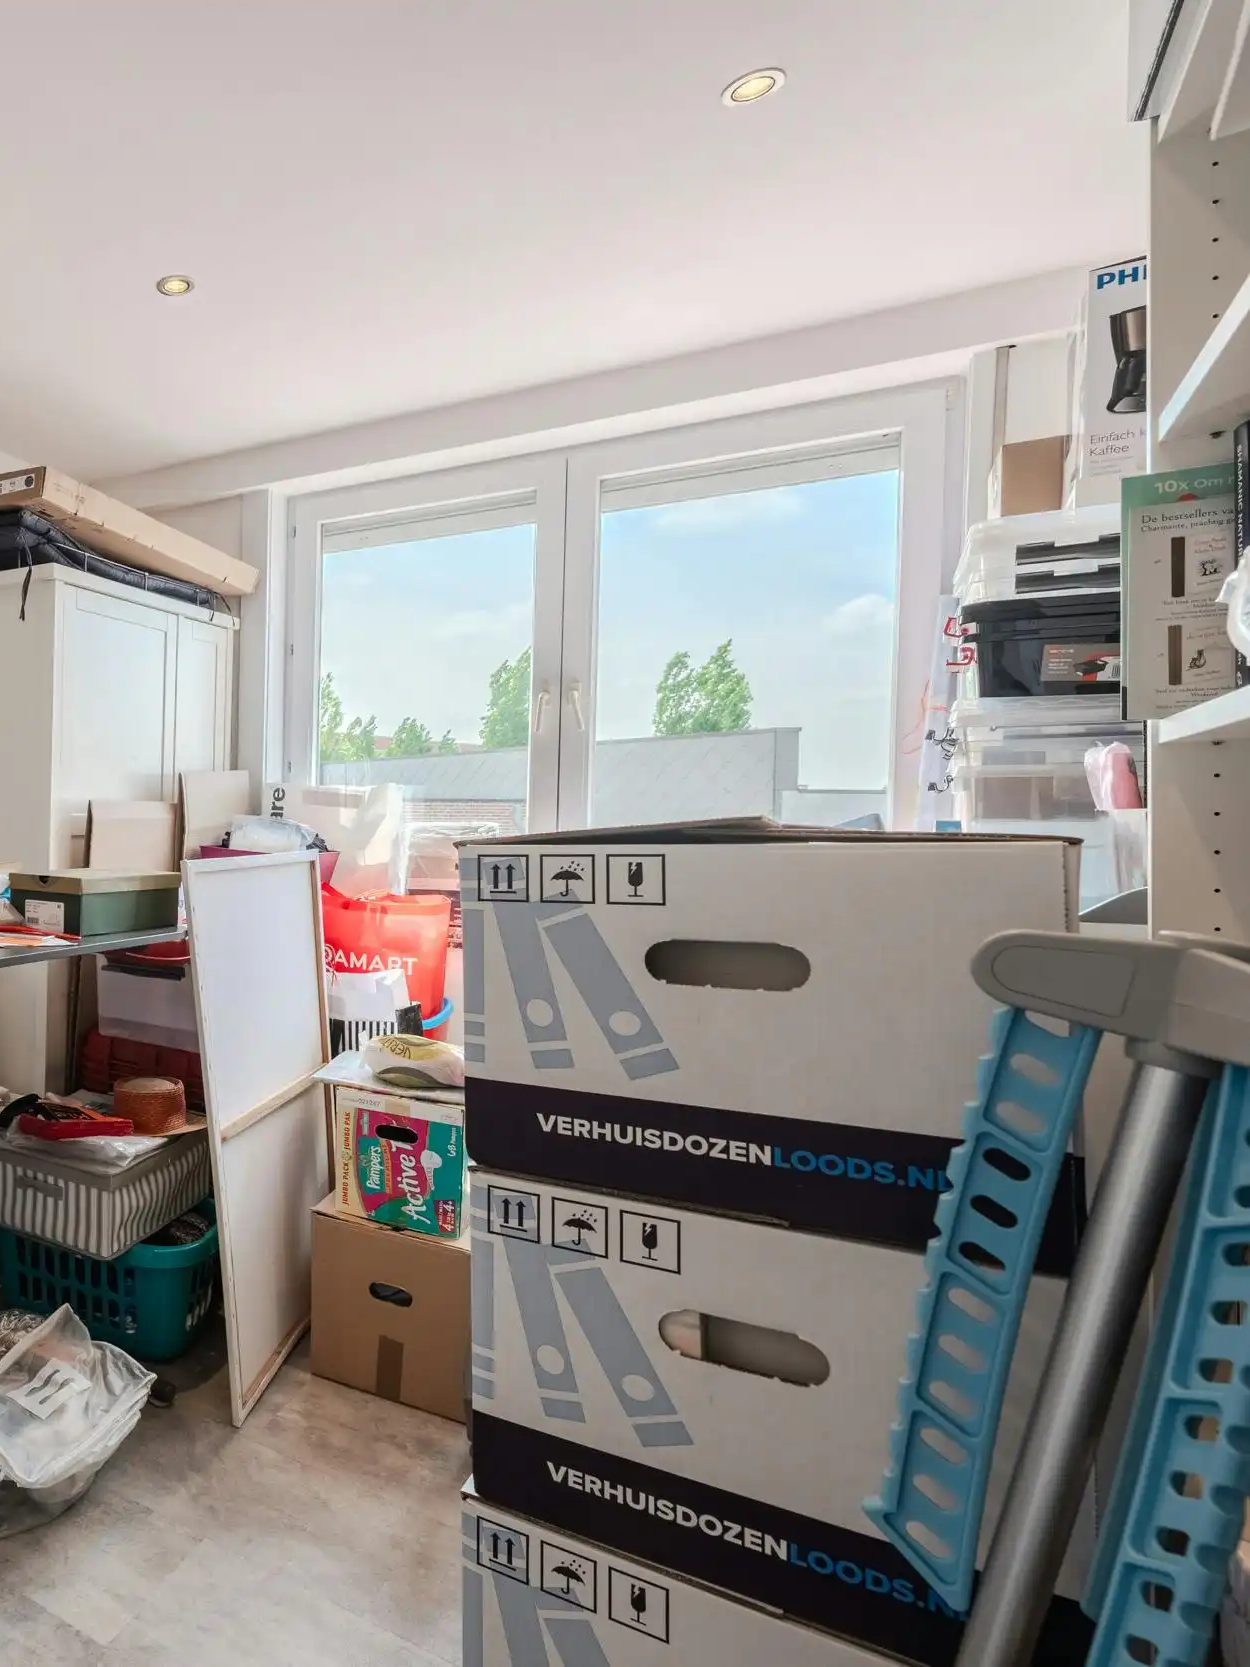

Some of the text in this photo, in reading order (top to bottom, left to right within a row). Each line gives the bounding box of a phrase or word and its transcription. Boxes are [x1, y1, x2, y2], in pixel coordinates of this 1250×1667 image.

[1090, 430, 1135, 444] Einfach
[1090, 443, 1130, 456] Kaffee
[1154, 480, 1189, 494] 10x
[1194, 479, 1223, 489] om
[1141, 514, 1157, 525] De
[1162, 508, 1219, 522] bestsellers
[1190, 519, 1224, 529] prachtig
[342, 1128, 351, 1150] JUMBO
[537, 1112, 955, 1193] VERHUISDOZENLOODS.NL
[366, 1145, 384, 1189] Pampers
[341, 1161, 350, 1205] JUMBO PACK
[396, 1154, 432, 1225] Active
